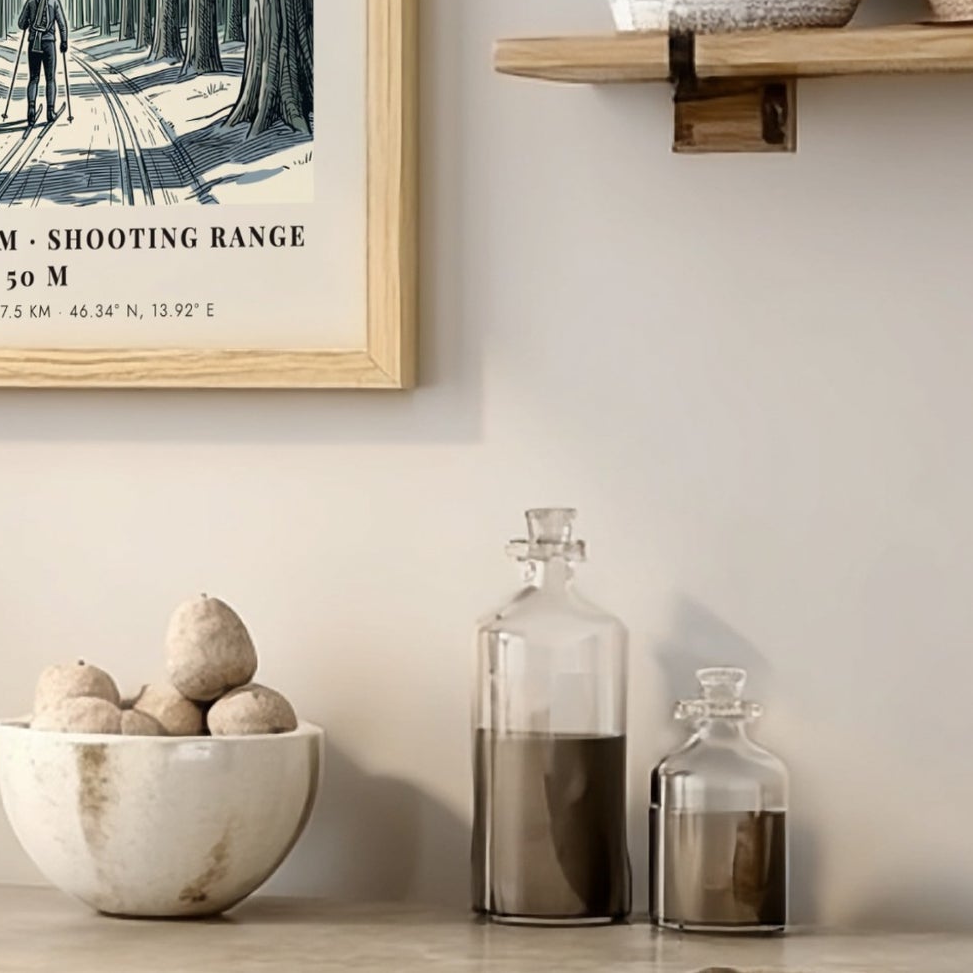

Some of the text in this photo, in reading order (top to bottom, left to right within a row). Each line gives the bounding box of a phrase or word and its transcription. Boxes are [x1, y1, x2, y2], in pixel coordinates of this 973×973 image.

[48, 227, 197, 250] SHOOTING
[211, 225, 304, 248] RANGE
[7, 265, 67, 291] 50 M
[1, 305, 22, 318] 7.5
[30, 305, 50, 318] KM
[70, 304, 119, 318] 46.34°
[127, 304, 143, 320] N,
[152, 303, 199, 317] 13.92°
[207, 303, 214, 317] E
